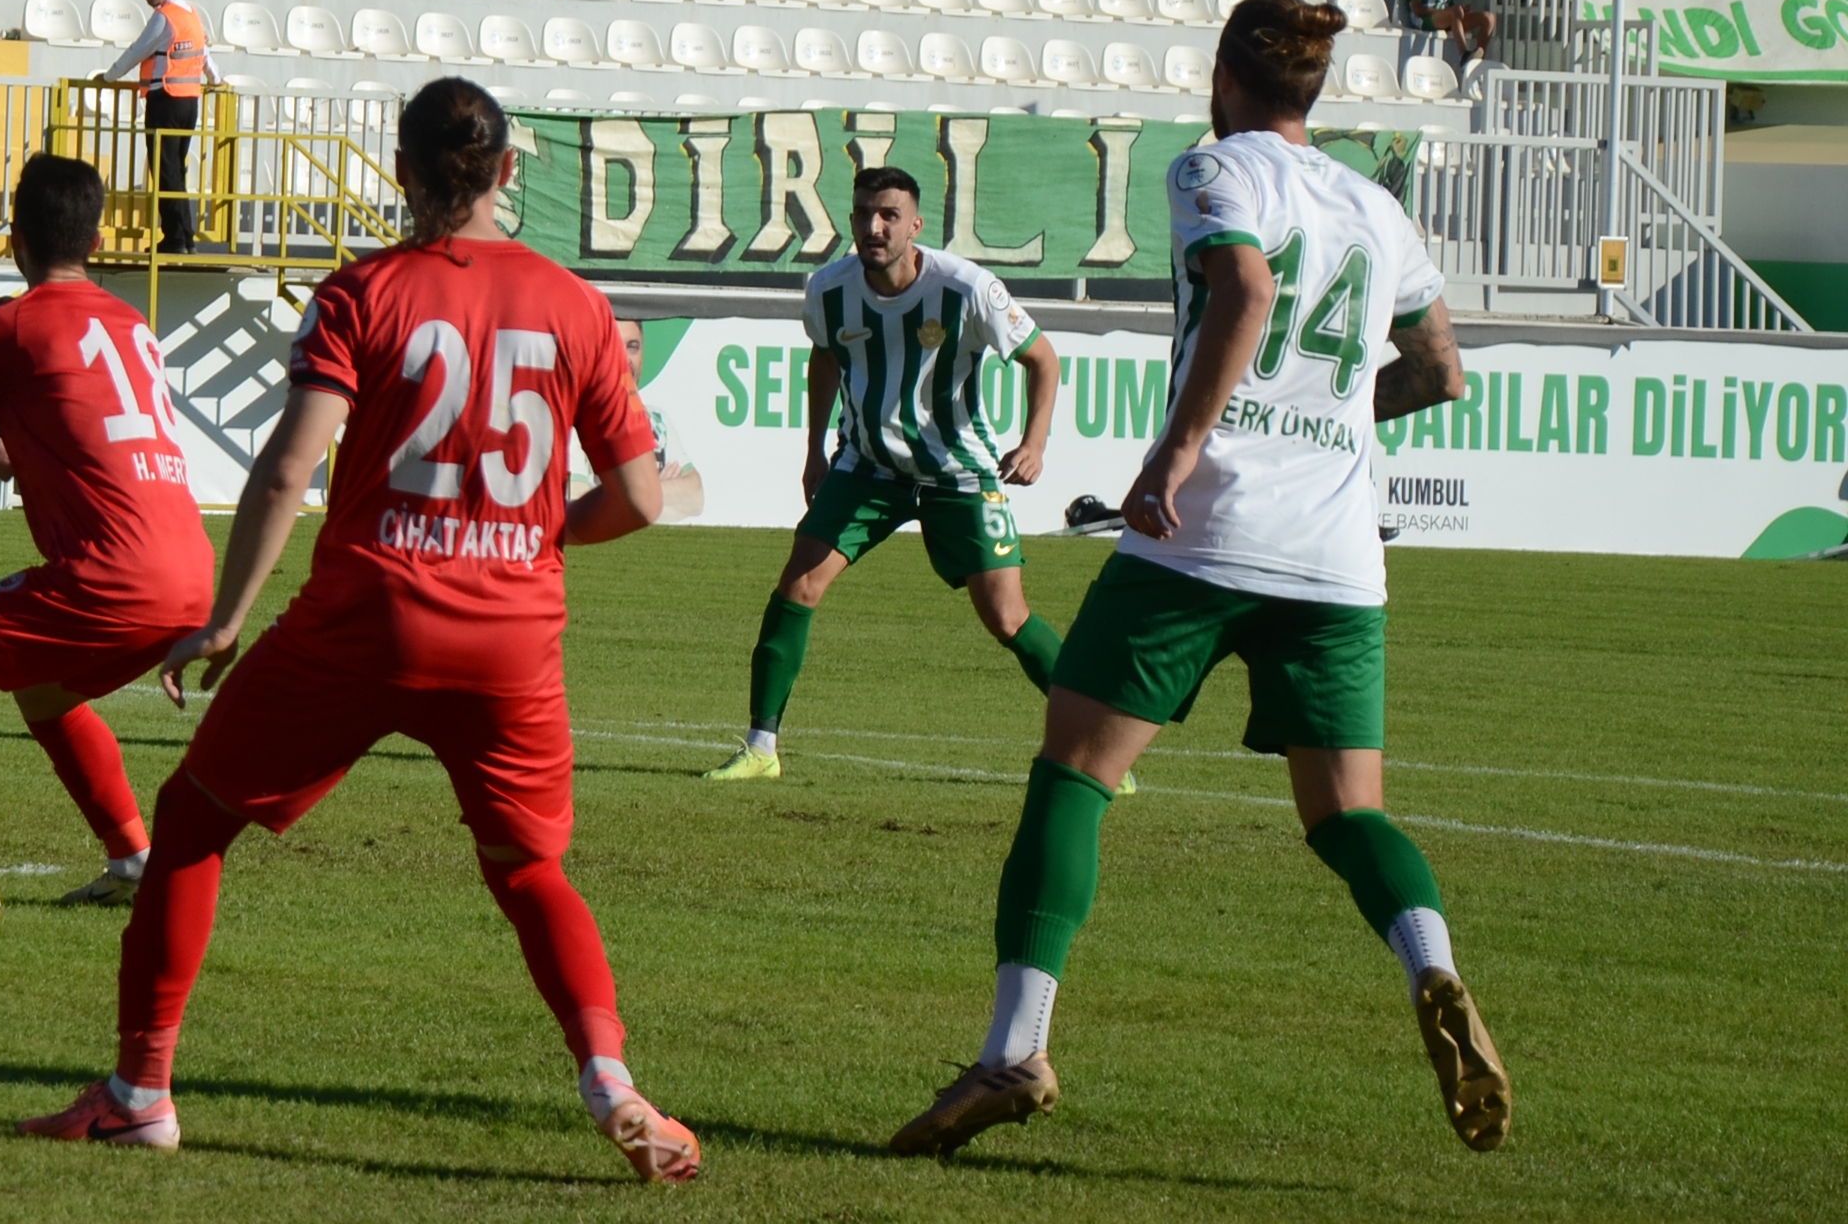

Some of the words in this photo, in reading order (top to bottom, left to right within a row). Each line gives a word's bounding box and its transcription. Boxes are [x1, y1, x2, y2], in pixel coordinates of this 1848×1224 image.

[1254, 226, 1372, 400] 14
[79, 317, 179, 445] 18
[389, 320, 558, 507] 25
[1221, 395, 1275, 435] ERK
[1388, 477, 1469, 507] KUMBUL
[1395, 513, 1469, 534] BAŞKANI
